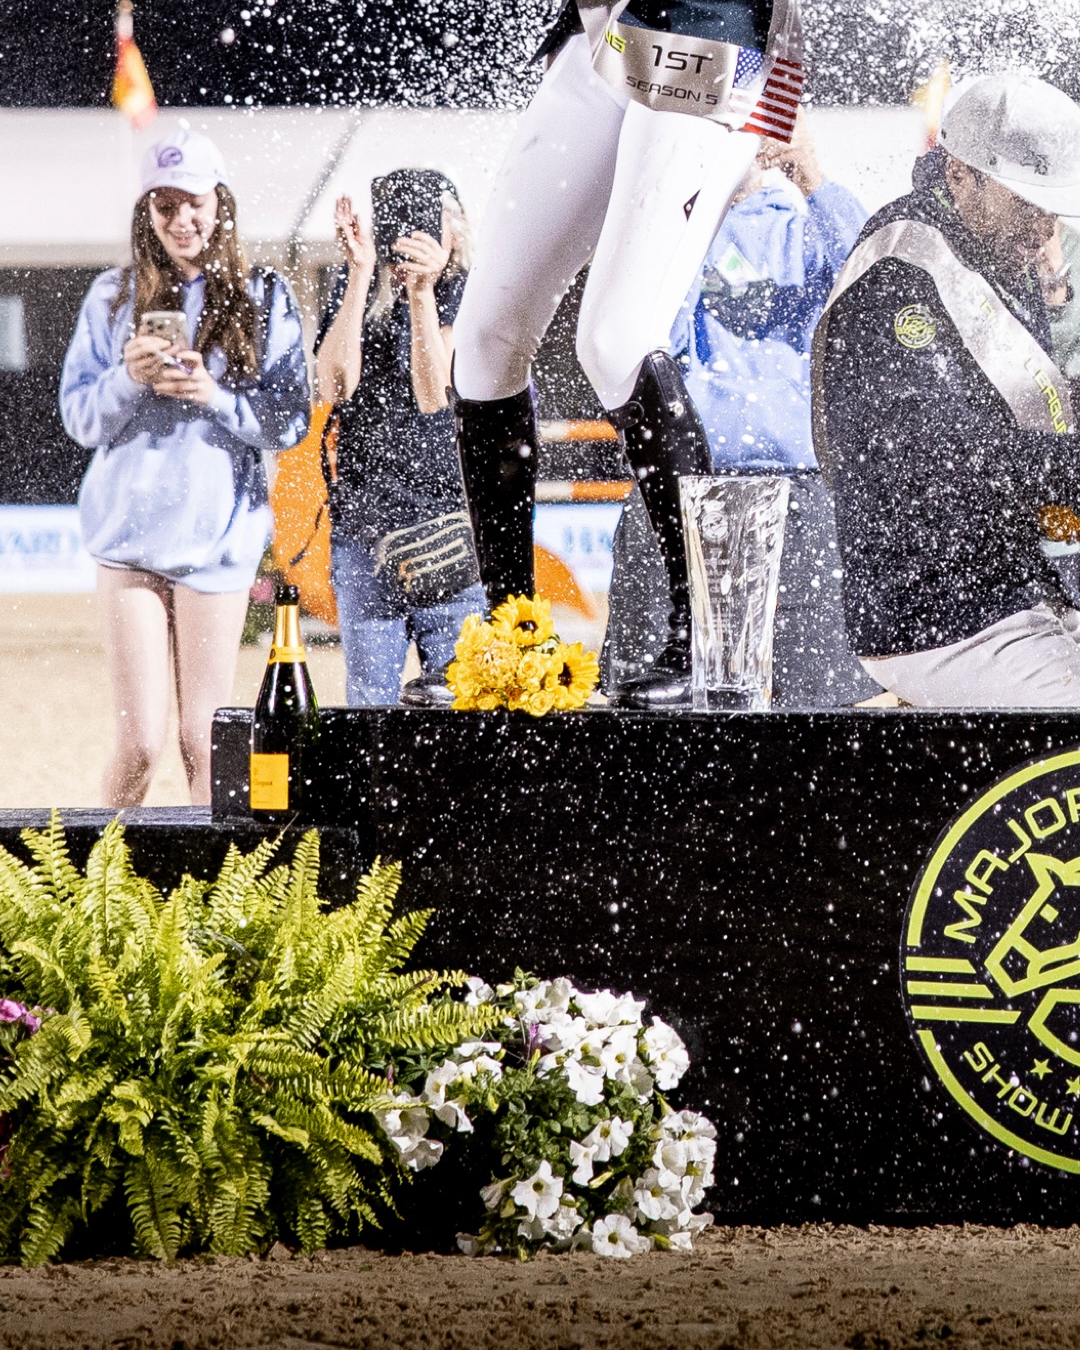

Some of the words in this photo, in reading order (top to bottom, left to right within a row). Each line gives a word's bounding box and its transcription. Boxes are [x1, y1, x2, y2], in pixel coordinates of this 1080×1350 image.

[651, 44, 714, 74] 1ST
[625, 75, 701, 103] SEASON
[705, 93, 719, 106] 5
[963, 1041, 1073, 1136] SHOW
